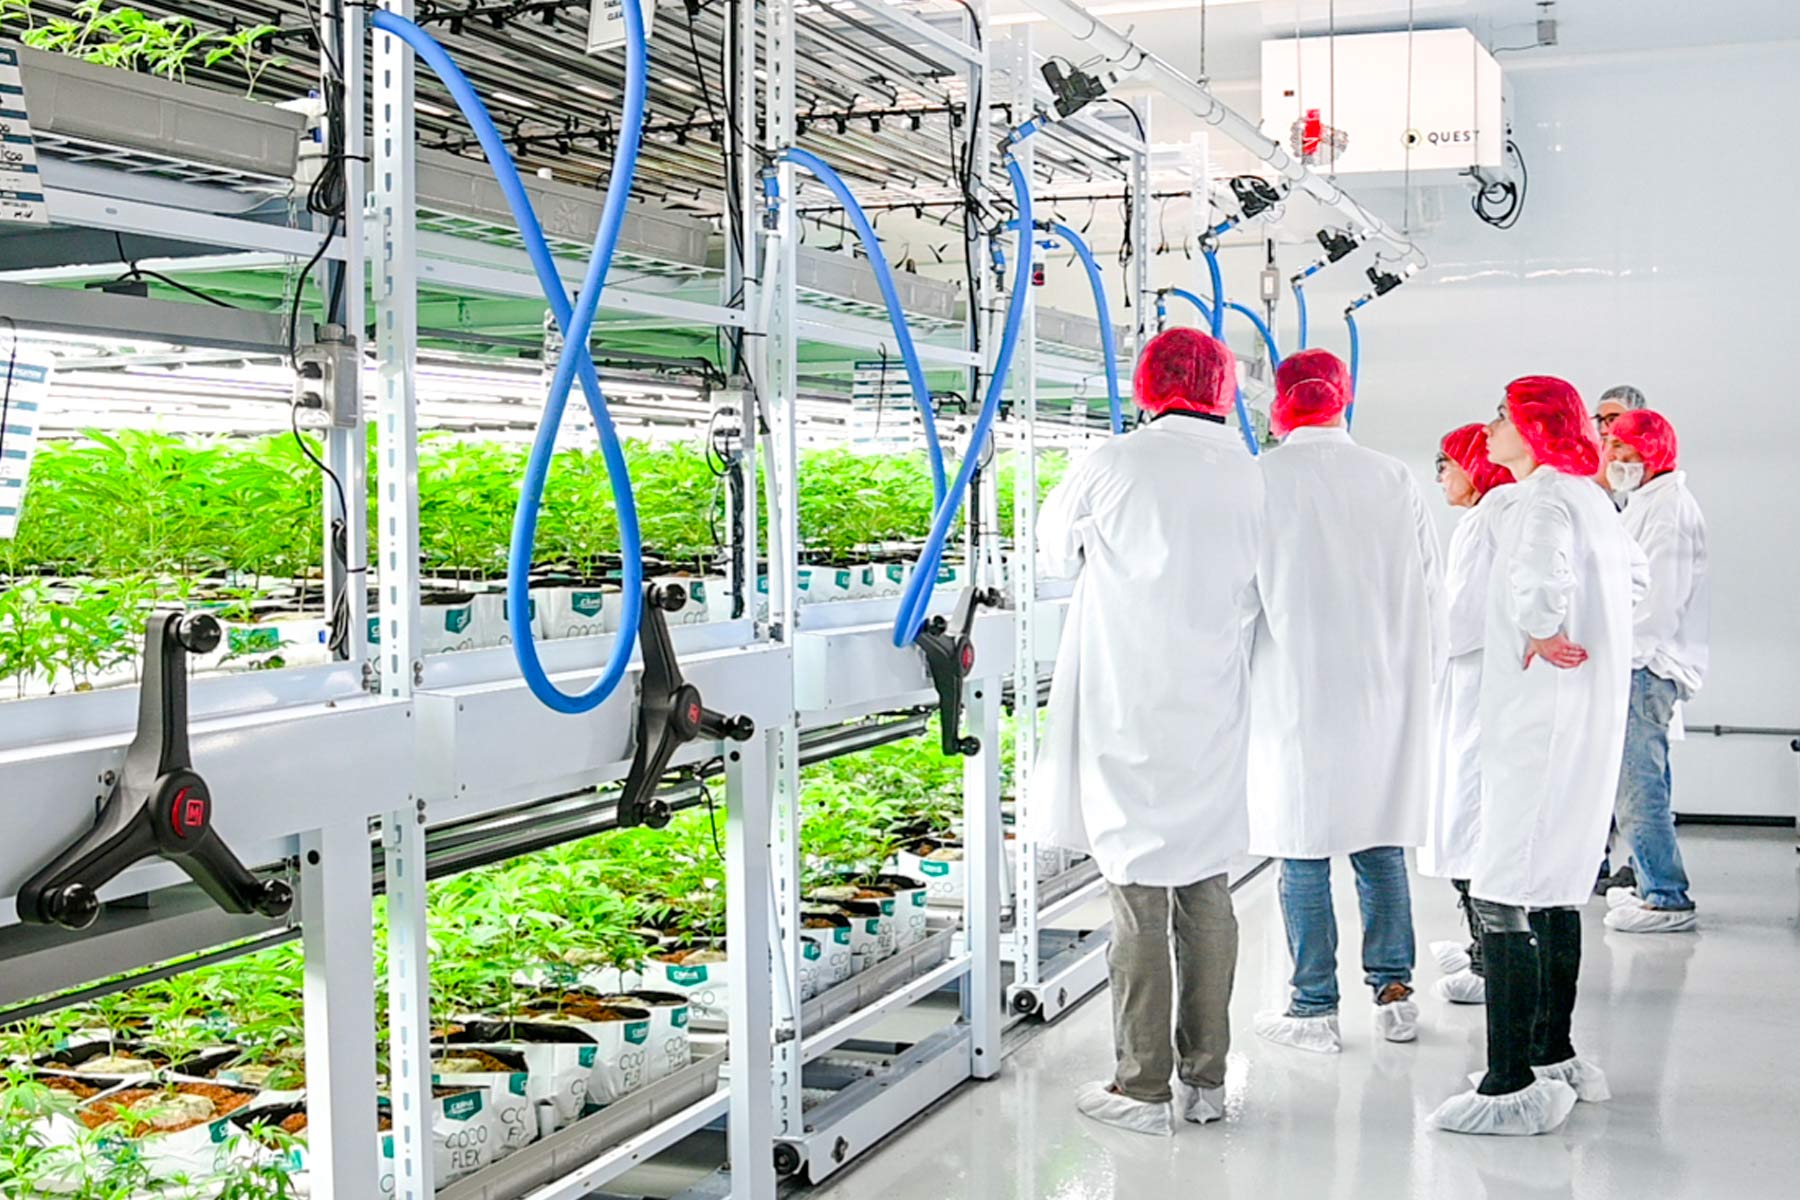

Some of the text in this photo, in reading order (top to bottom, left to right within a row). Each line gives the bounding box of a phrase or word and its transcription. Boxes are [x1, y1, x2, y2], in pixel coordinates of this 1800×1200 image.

[1427, 130, 1480, 146] QUEST
[444, 1125, 488, 1150] COCO
[451, 1149, 481, 1169] FLEX
